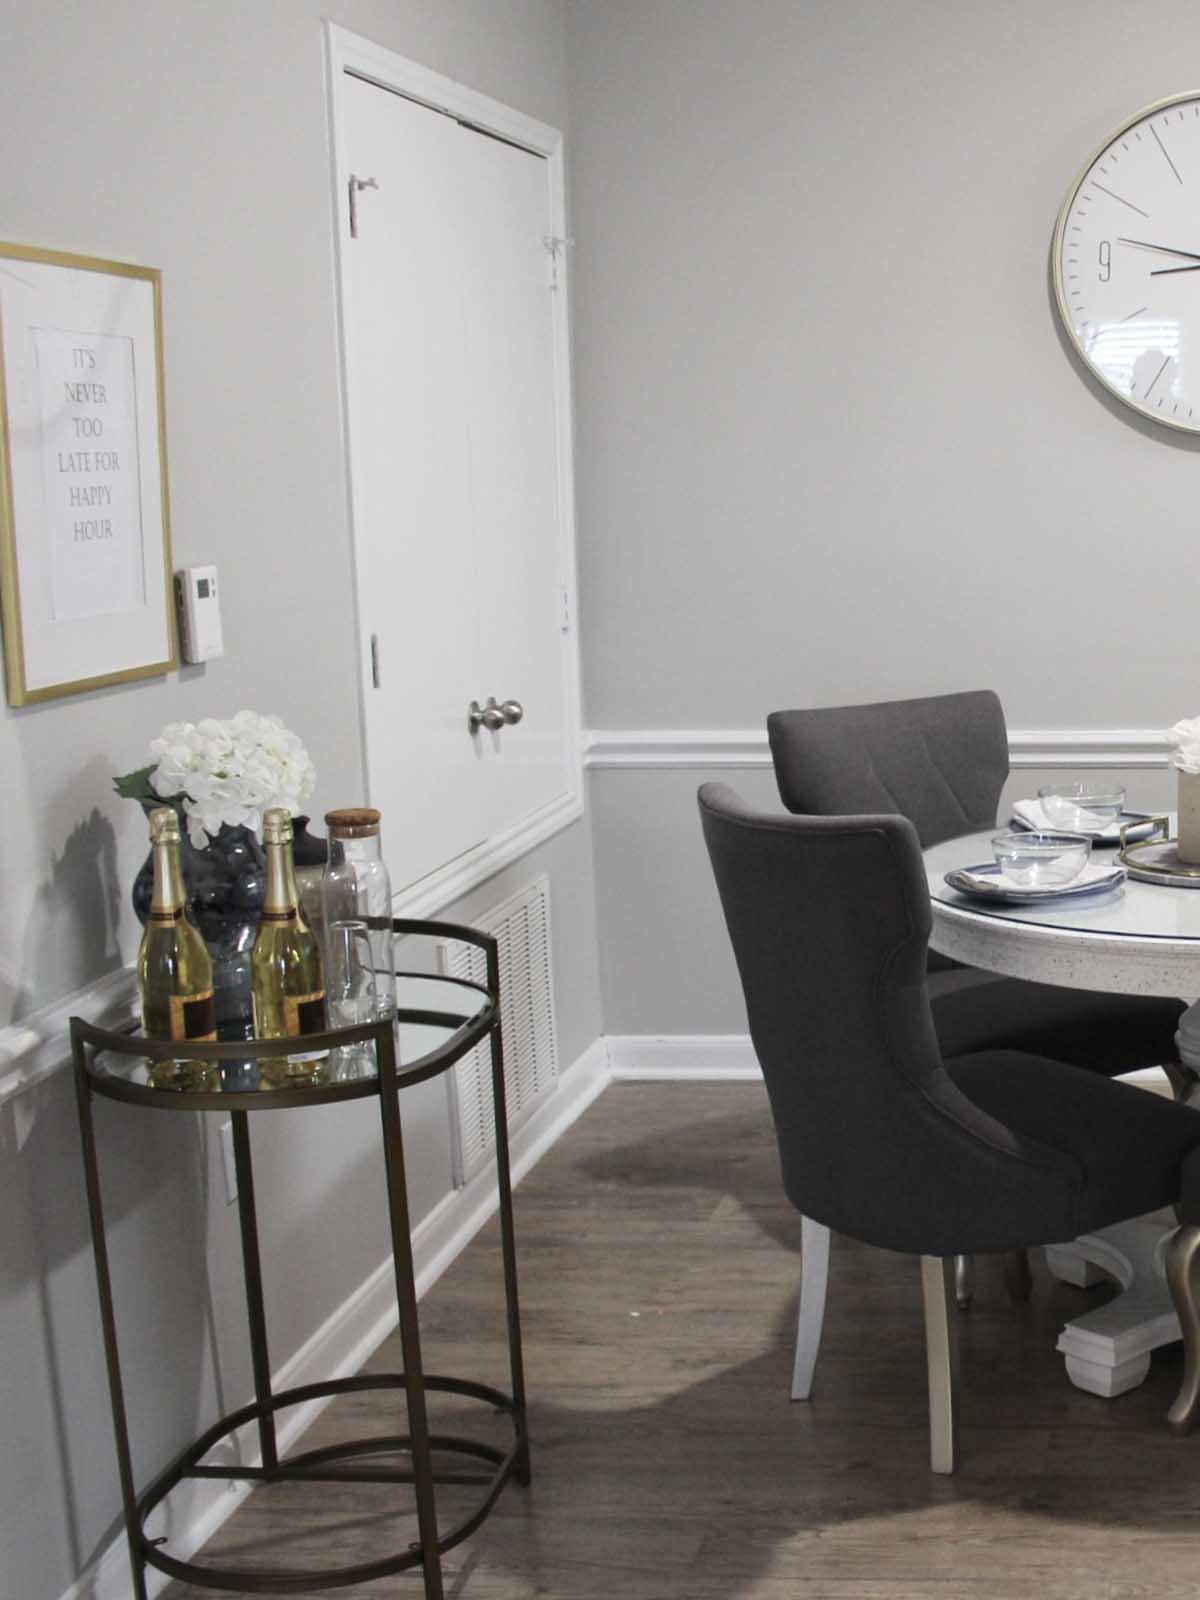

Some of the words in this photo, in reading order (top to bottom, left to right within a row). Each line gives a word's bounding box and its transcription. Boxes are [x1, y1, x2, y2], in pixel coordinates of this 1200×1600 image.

[1098, 240, 1111, 282] 9
[71, 347, 96, 369] IT'S
[64, 382, 106, 404] NEVER
[72, 416, 103, 439] TOO
[58, 451, 91, 473] LATE
[95, 451, 121, 472] FOR
[69, 484, 112, 507] HAPPY
[73, 518, 113, 542] HOUR
